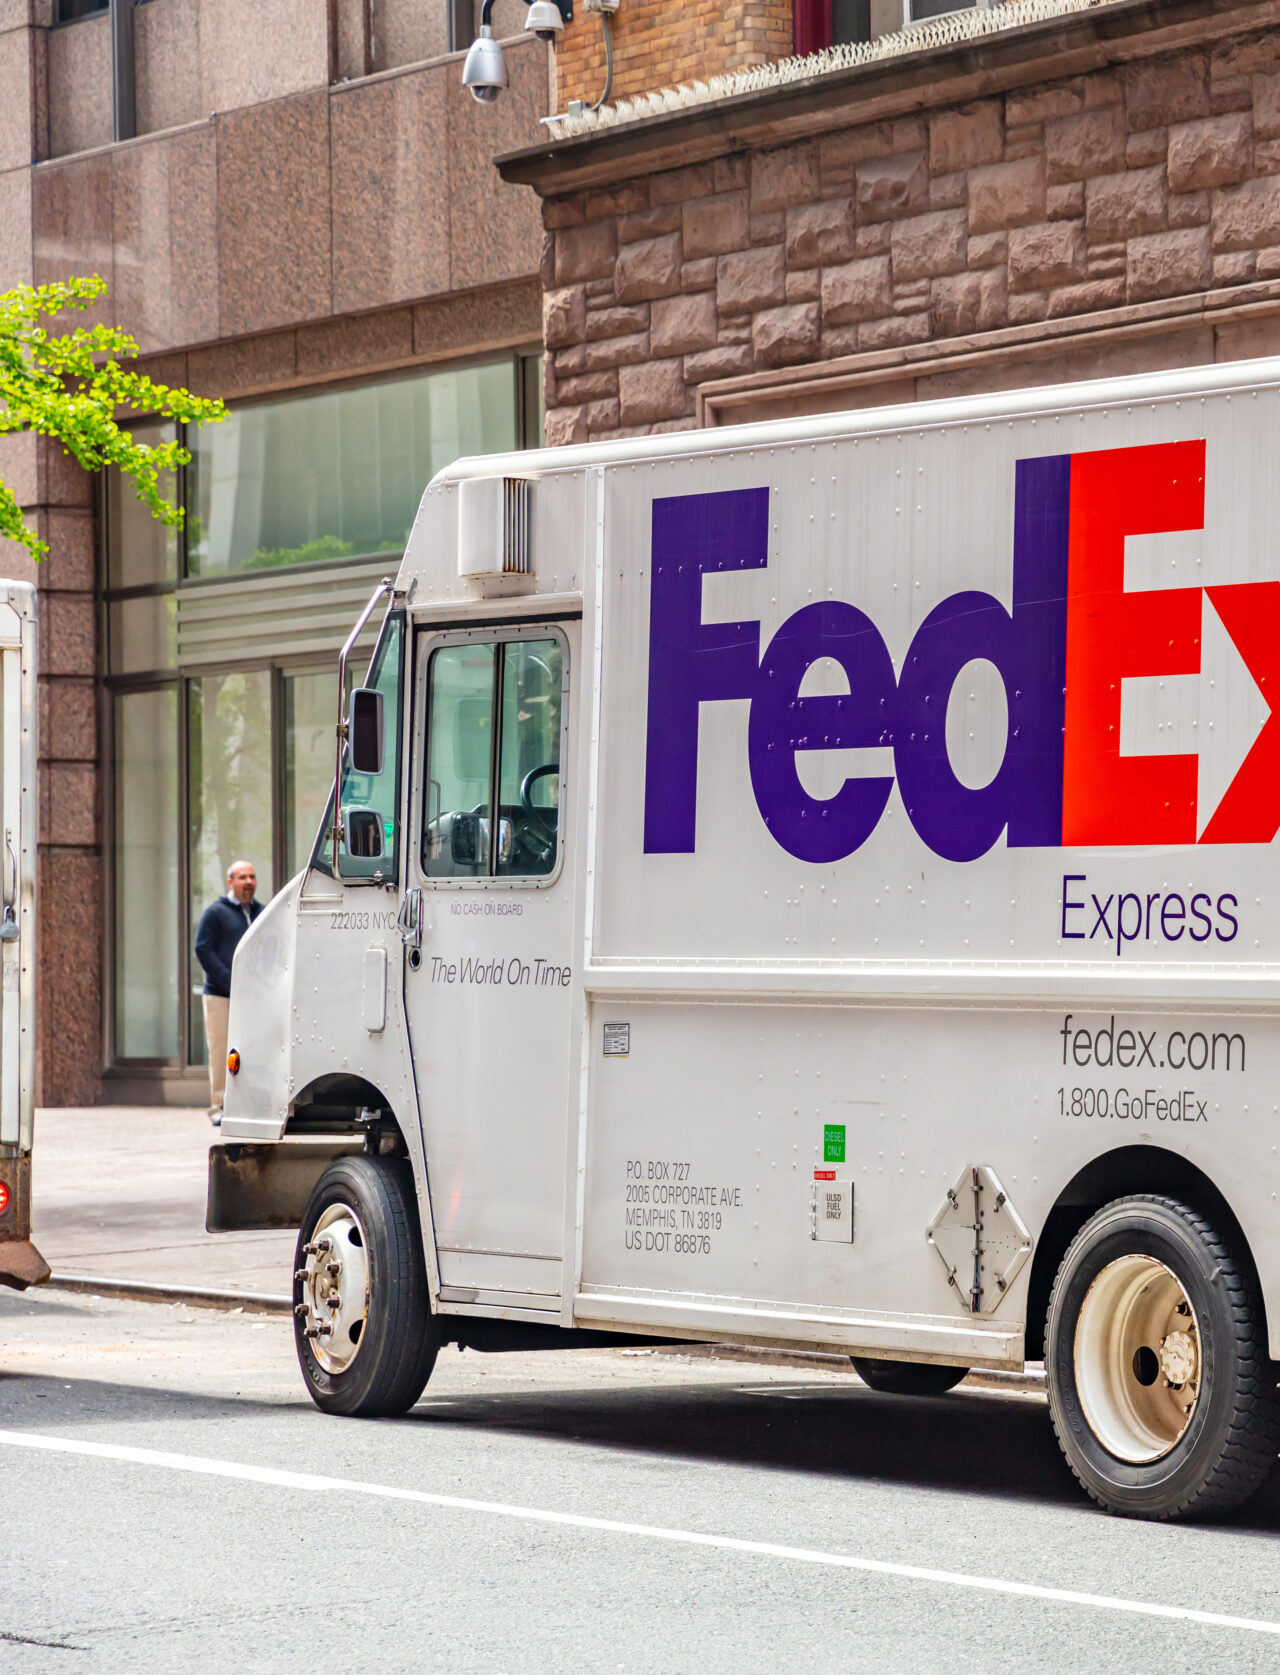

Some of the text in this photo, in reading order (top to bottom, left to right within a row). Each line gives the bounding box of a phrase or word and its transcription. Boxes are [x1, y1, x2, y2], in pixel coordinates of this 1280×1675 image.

[450, 903, 523, 916] NO CASH ON BOARD
[1061, 875, 1239, 956] Express
[330, 911, 396, 930] 222033 NYC
[431, 957, 571, 987] The World On Time
[1060, 1014, 1246, 1072] fedex.com
[1057, 1087, 1208, 1122] 1.800.GoFedEx
[824, 1131, 844, 1142] DIESEL
[827, 1145, 842, 1156] ONLY
[626, 1160, 690, 1181] P.O. BOX 727
[626, 1184, 743, 1207] 2005 CORPORATE AVE.
[826, 1193, 841, 1202] ULSD
[826, 1202, 841, 1210] FUEL
[625, 1207, 722, 1231] MEMPHIS, TN 3819
[826, 1211, 841, 1220] ONLY
[625, 1230, 711, 1254] US DOT 86876
